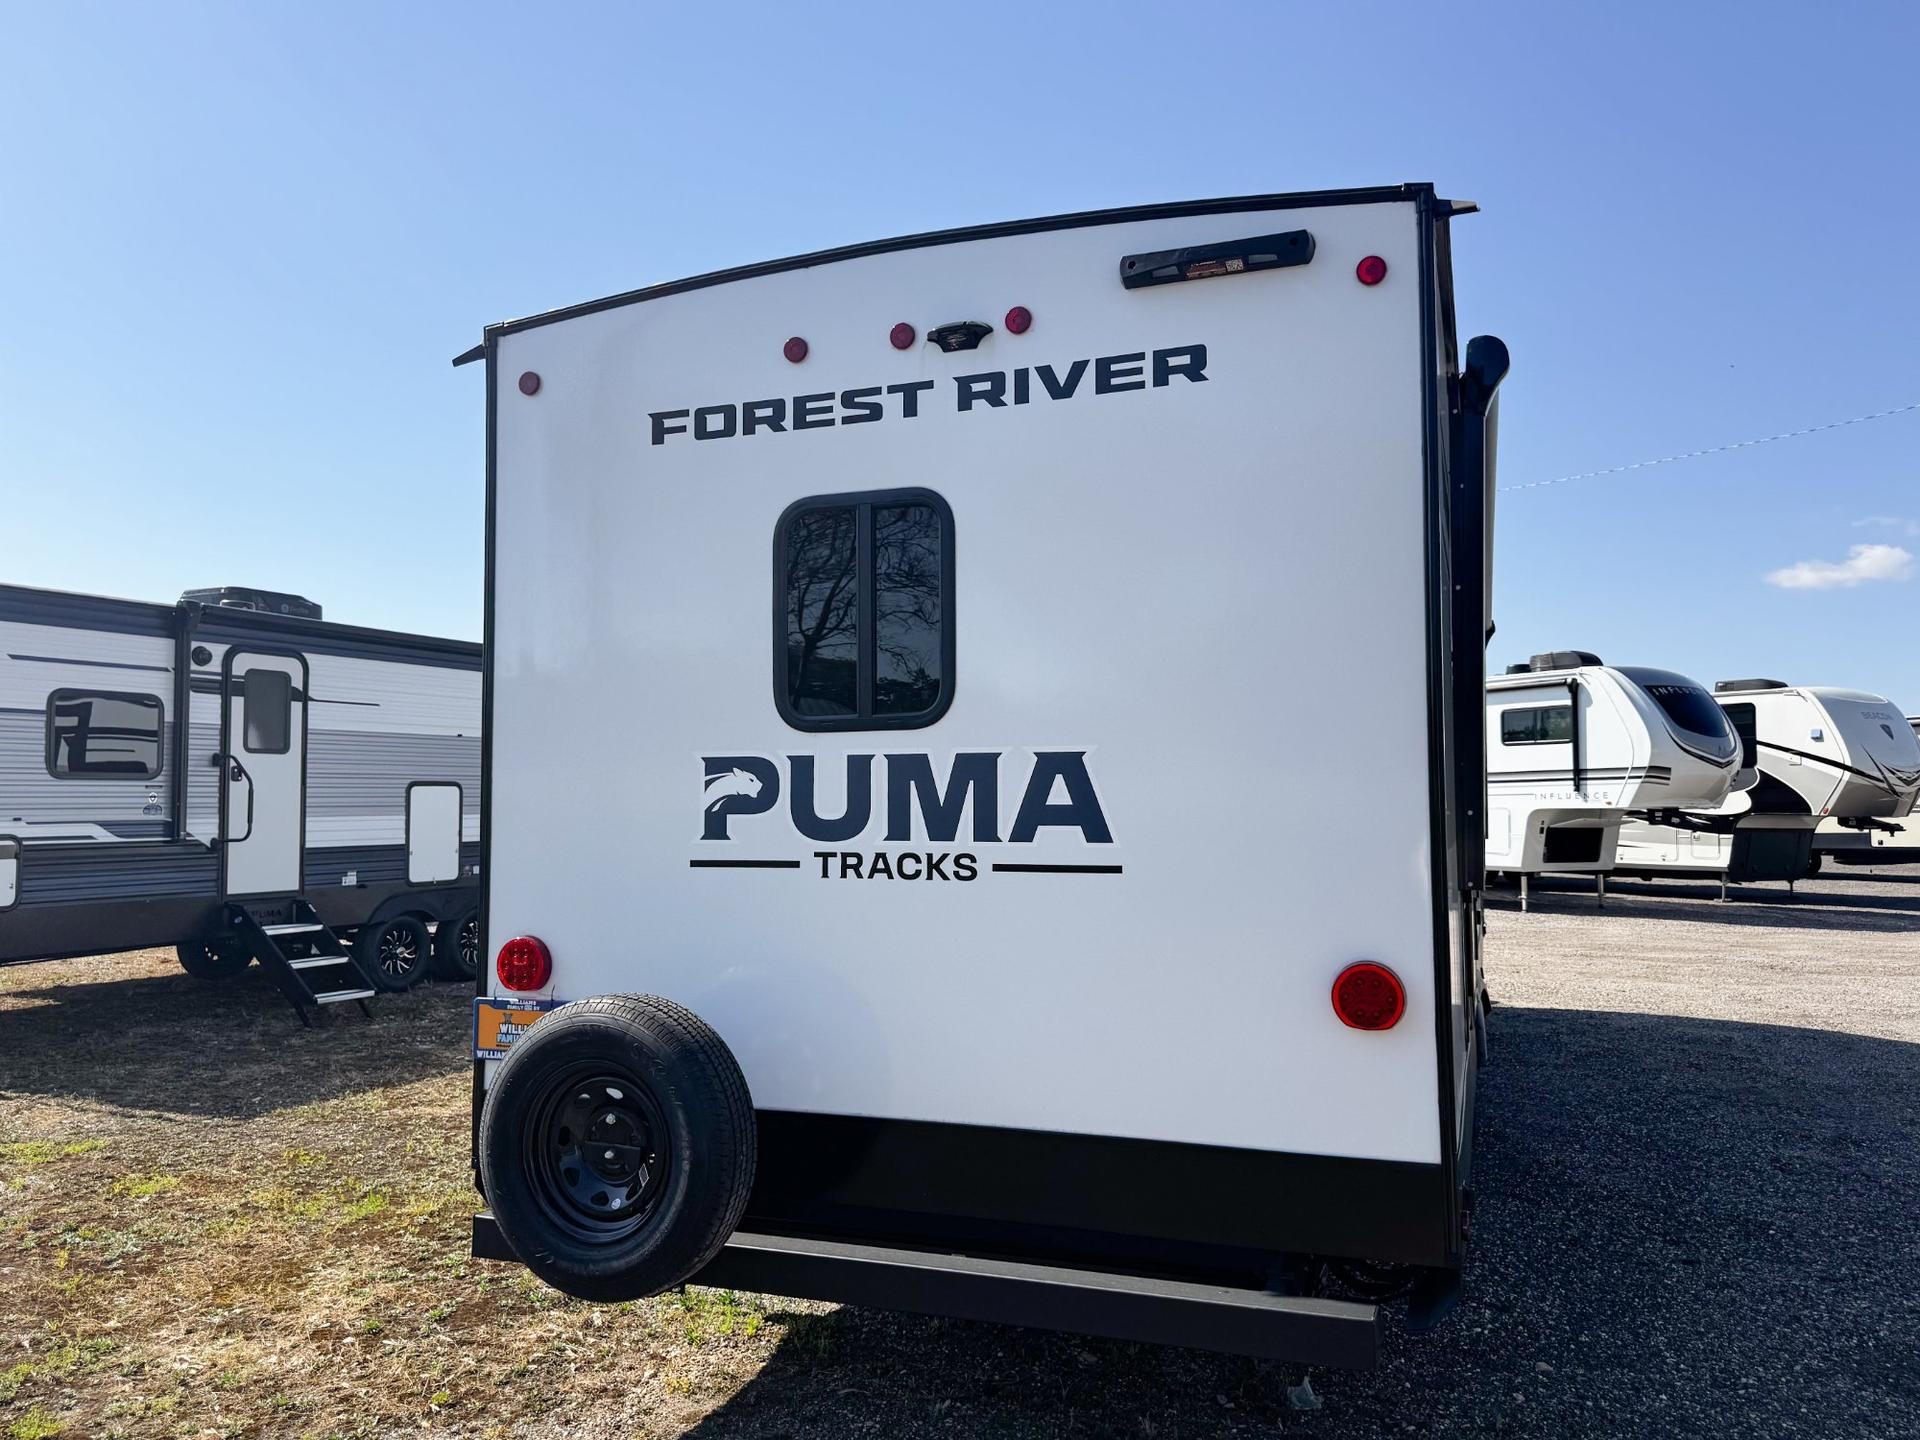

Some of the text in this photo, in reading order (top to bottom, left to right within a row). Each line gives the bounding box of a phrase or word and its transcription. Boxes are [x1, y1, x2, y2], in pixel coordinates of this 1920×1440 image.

[648, 344, 1209, 445] FOREST RIVER
[700, 751, 1114, 844] PUMA
[1534, 792, 1609, 800] INFLUENCE
[813, 851, 978, 881] TRACKS
